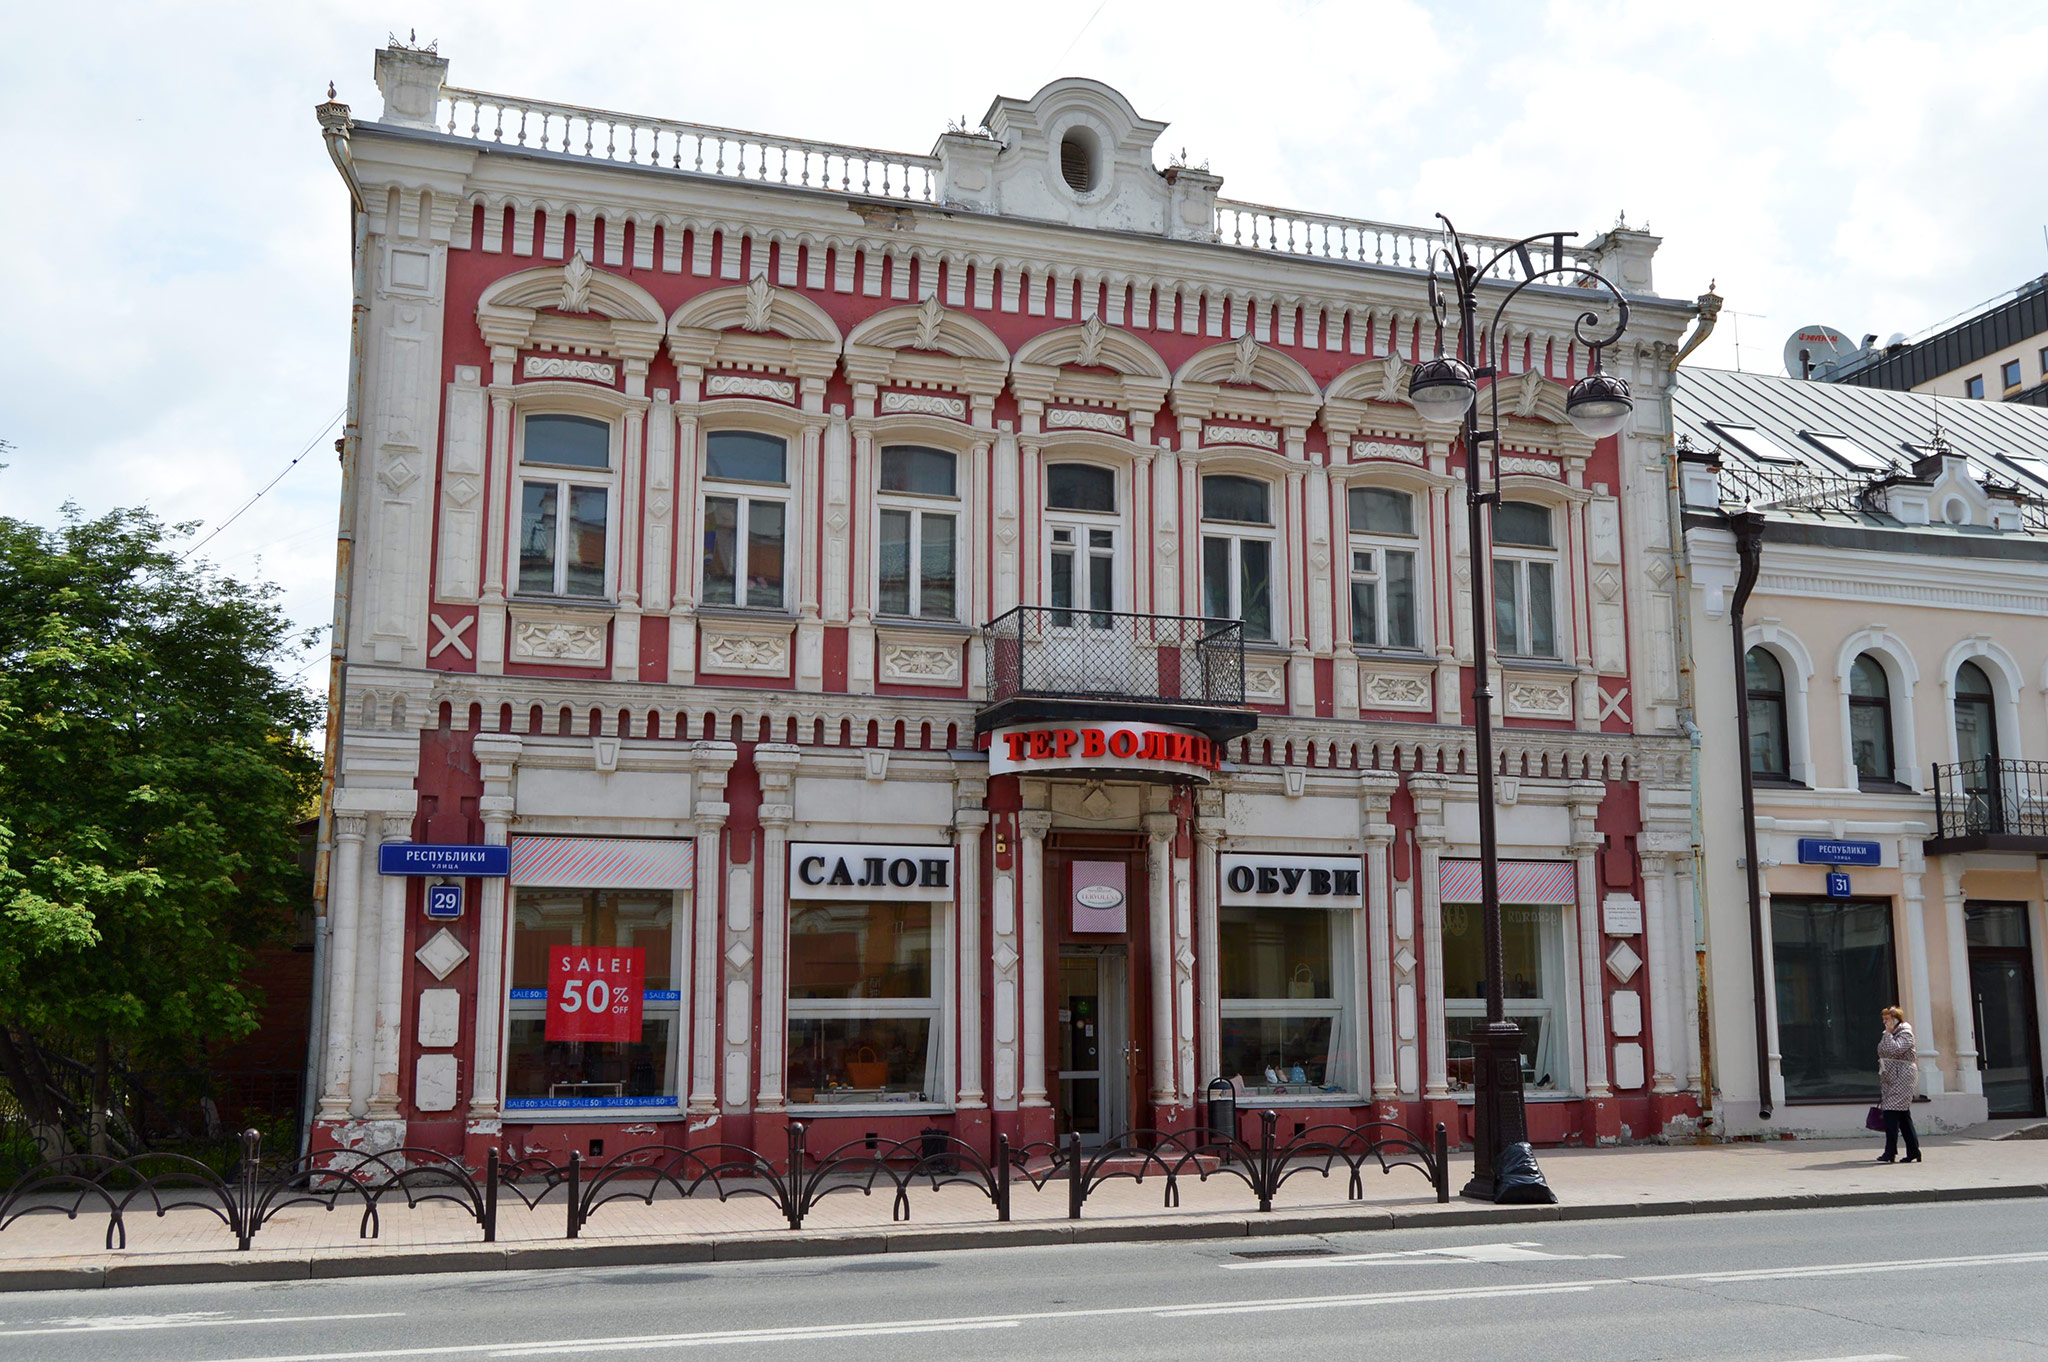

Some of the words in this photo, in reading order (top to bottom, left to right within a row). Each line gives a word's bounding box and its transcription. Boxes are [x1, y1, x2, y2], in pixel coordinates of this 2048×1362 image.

[1799, 333, 1838, 342] UNIVERAL
[1003, 729, 1221, 771] ТЕРВОЛИНА
[1818, 845, 1867, 855] РЕСПУБЛИКИ
[406, 851, 486, 862] РЕСПУБЛИКИ
[798, 856, 950, 887] САЛОН
[1228, 865, 1361, 896] ОБУВИ
[1836, 878, 1847, 891] 31
[434, 893, 457, 909] 29
[561, 957, 631, 973] SALE!
[512, 990, 529, 998] SALE
[559, 979, 629, 1014] 50%
[649, 991, 665, 999] SALE
[612, 1005, 629, 1014] OFF
[507, 1100, 524, 1108] SALE
[540, 1099, 557, 1107] SALE
[572, 1099, 589, 1107] SALE
[607, 1098, 623, 1106] SALE
[639, 1098, 655, 1106] SALE
